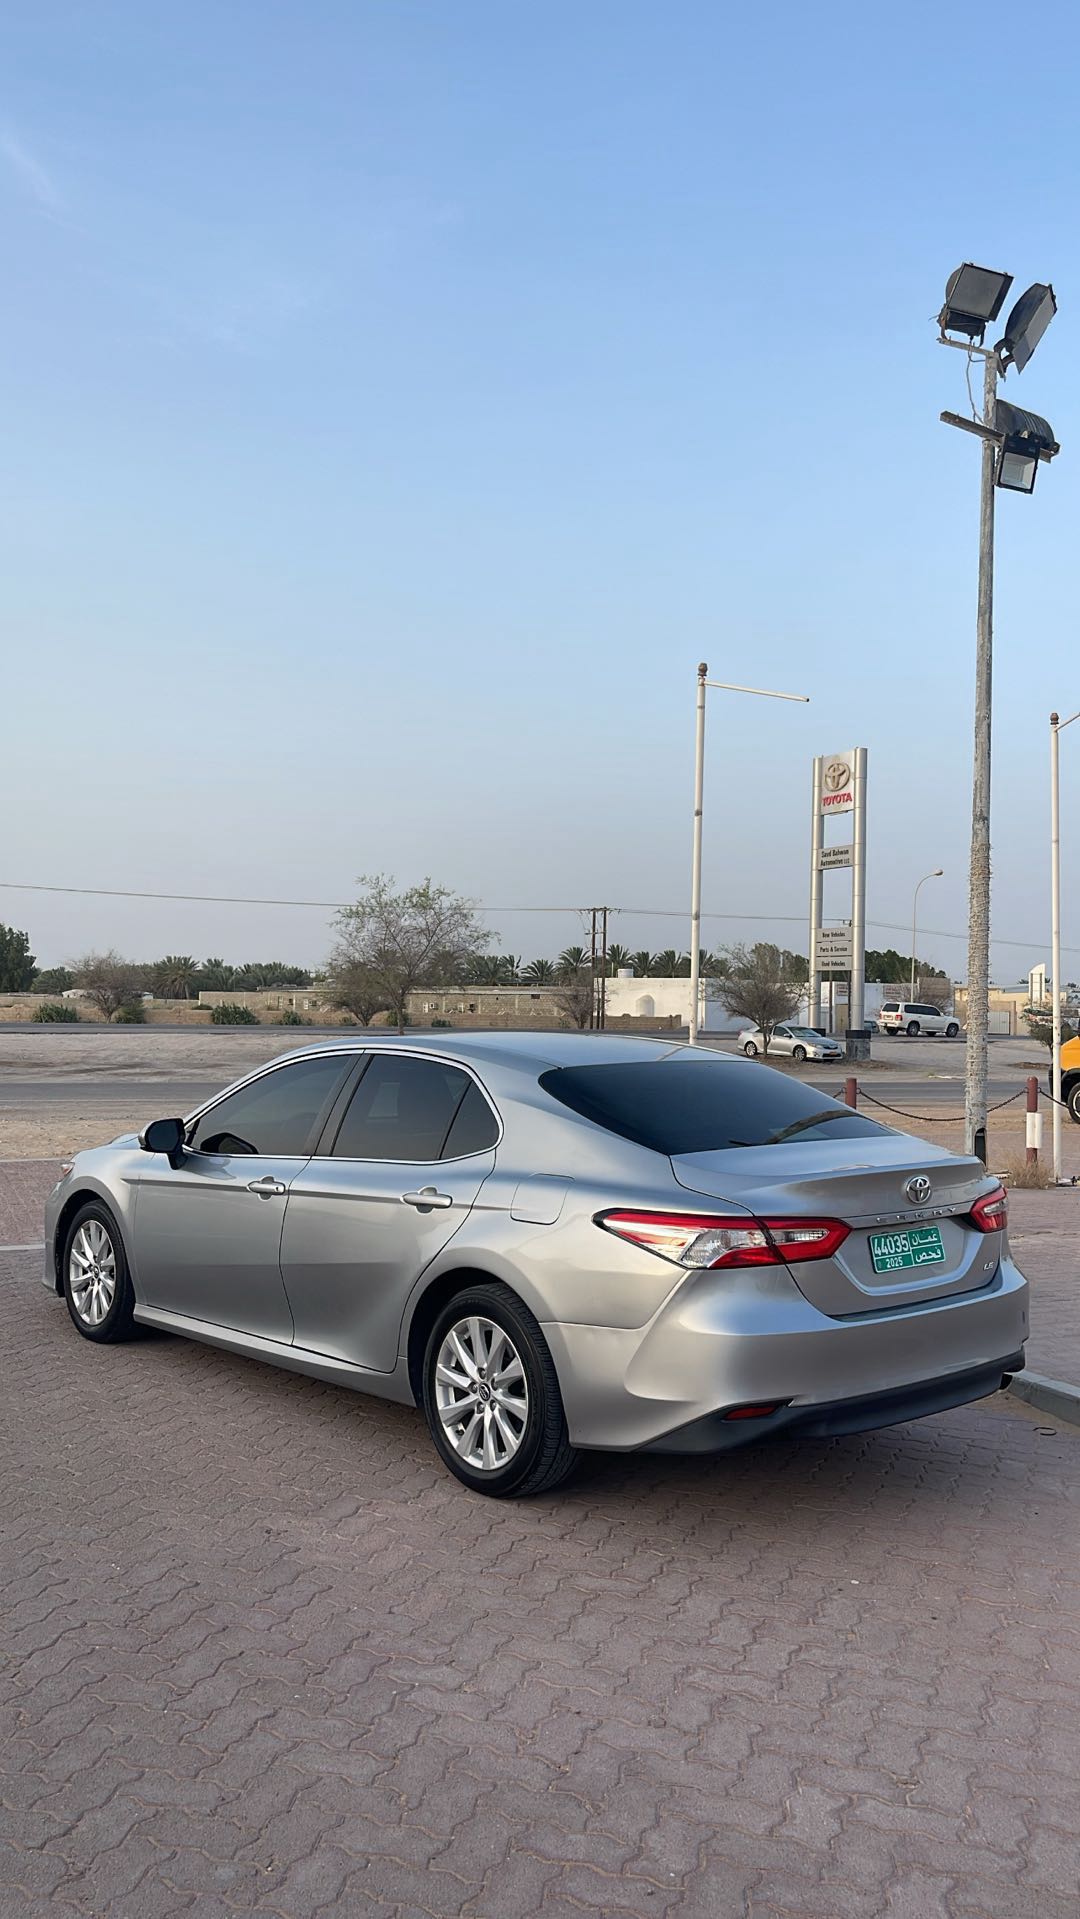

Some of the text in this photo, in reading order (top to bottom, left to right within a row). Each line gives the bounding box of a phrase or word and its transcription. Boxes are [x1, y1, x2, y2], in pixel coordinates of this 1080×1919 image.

[822, 792, 852, 806] TOYOTA
[874, 1234, 910, 1255] 44035
[915, 1247, 942, 1262] فحص
[886, 1256, 904, 1268] 2025
[983, 1261, 995, 1271] LE
